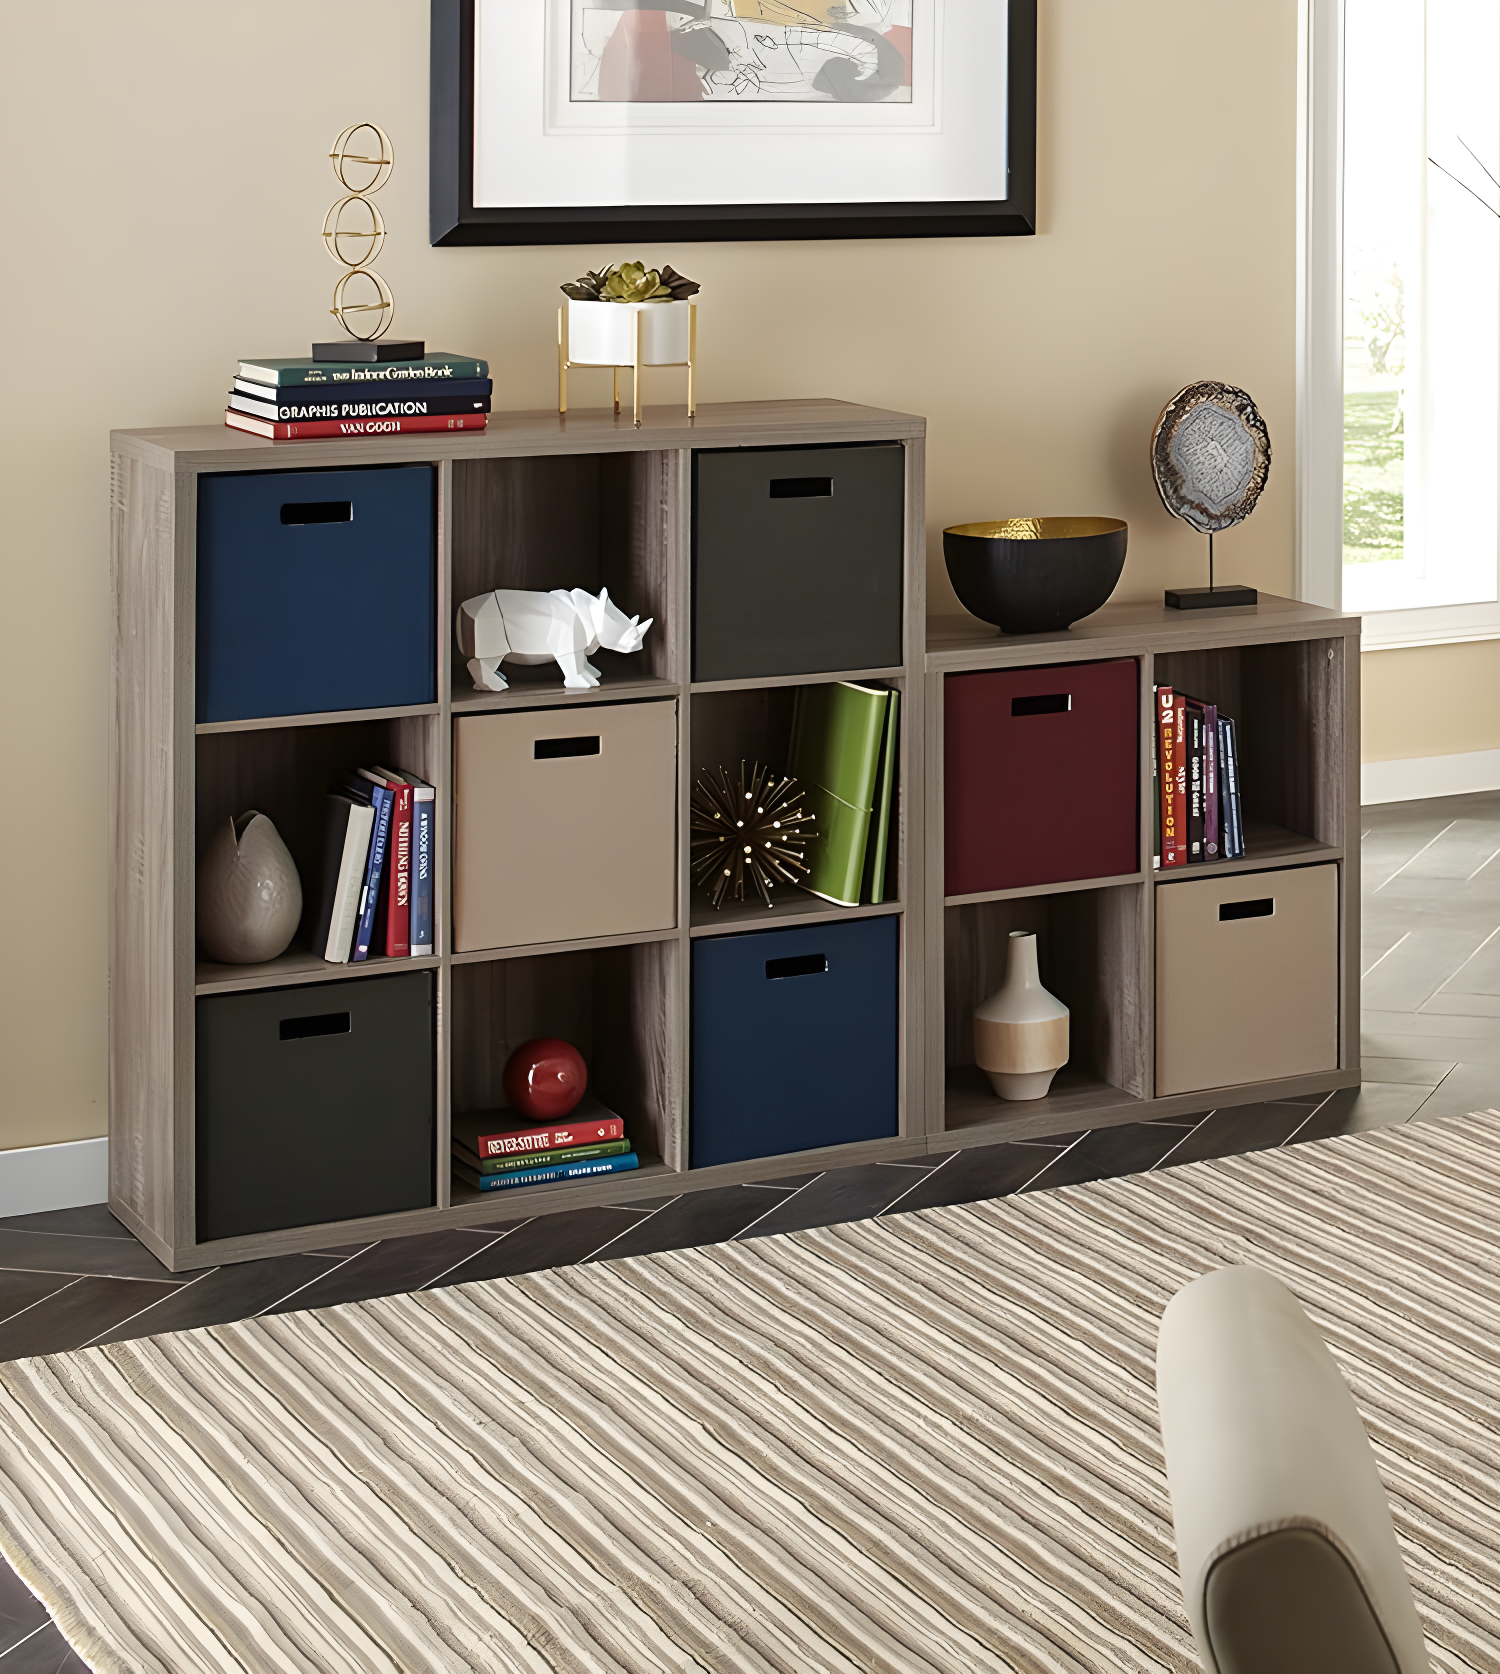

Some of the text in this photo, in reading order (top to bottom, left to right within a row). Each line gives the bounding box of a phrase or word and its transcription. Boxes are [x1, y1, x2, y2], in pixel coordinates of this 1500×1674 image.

[279, 401, 428, 420] GRAPHIS PUBLICATION
[1164, 728, 1175, 837] REVOLUTION
